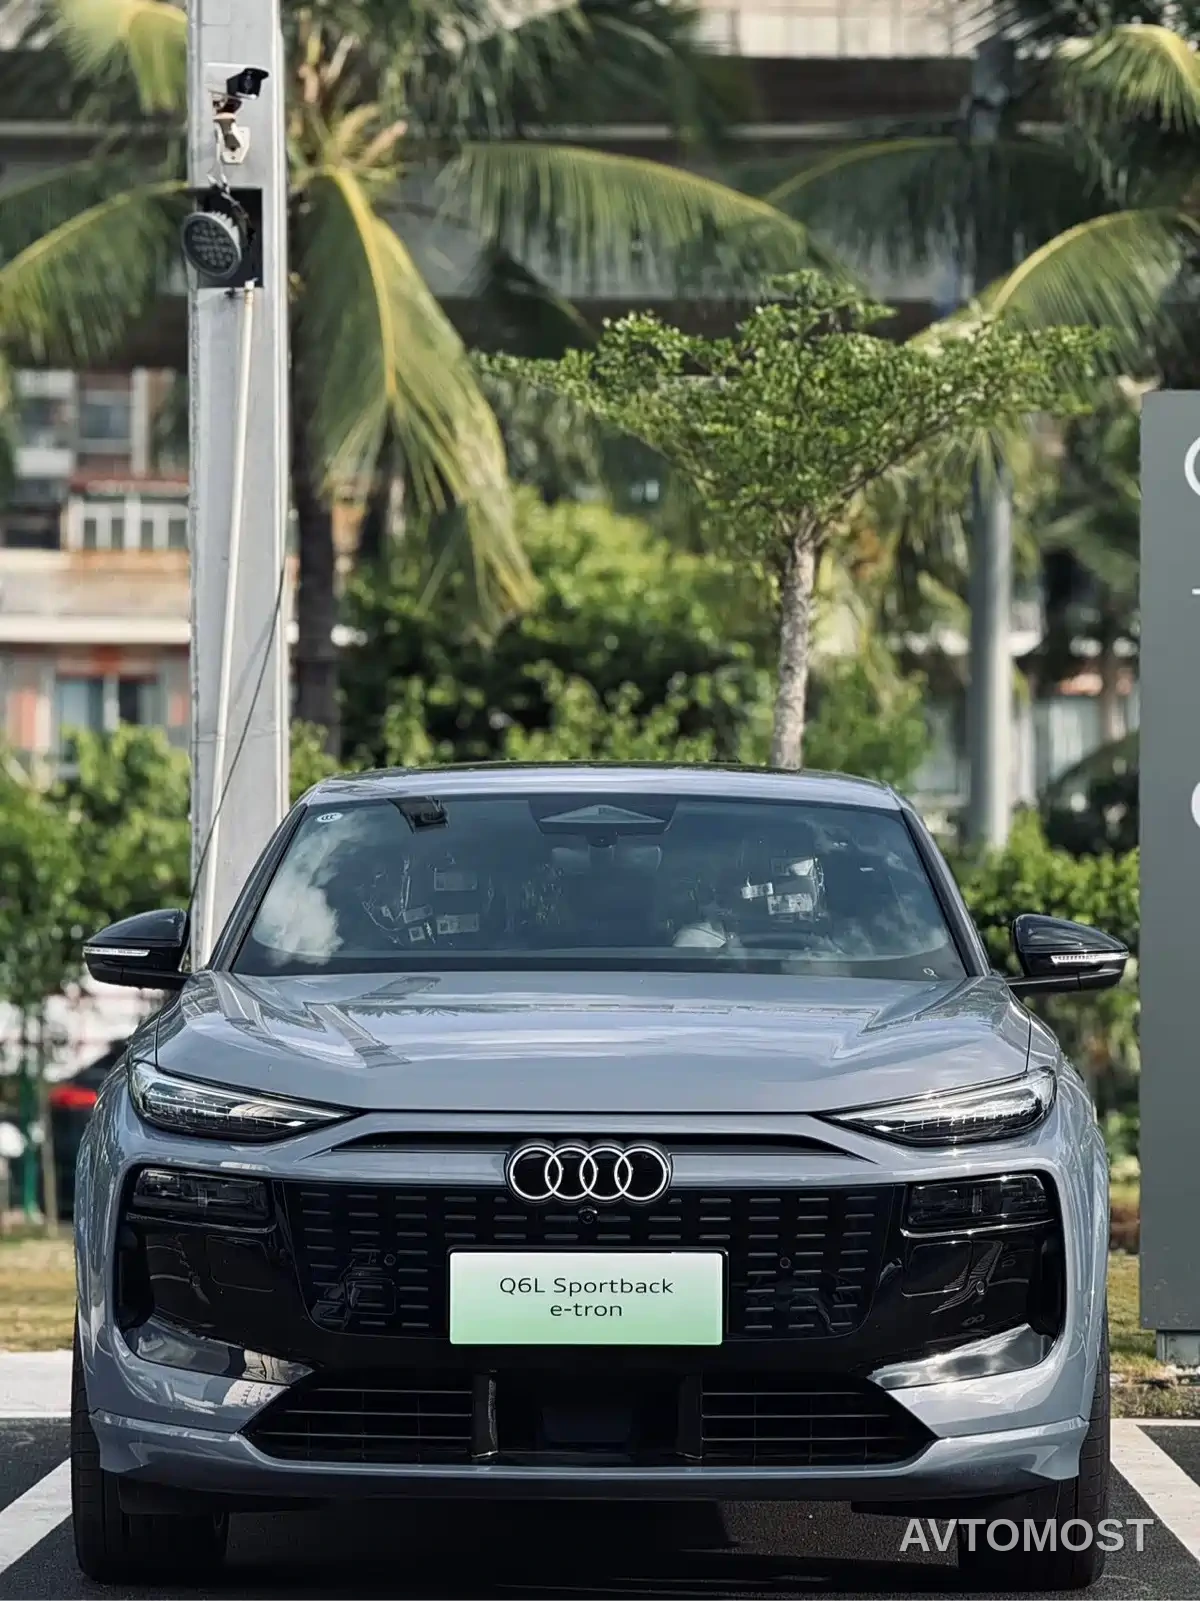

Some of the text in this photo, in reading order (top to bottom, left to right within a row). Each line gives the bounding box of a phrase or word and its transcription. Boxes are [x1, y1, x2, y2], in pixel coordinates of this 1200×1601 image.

[499, 1277, 674, 1297] Q6L Sportback
[550, 1302, 623, 1317] e-tron
